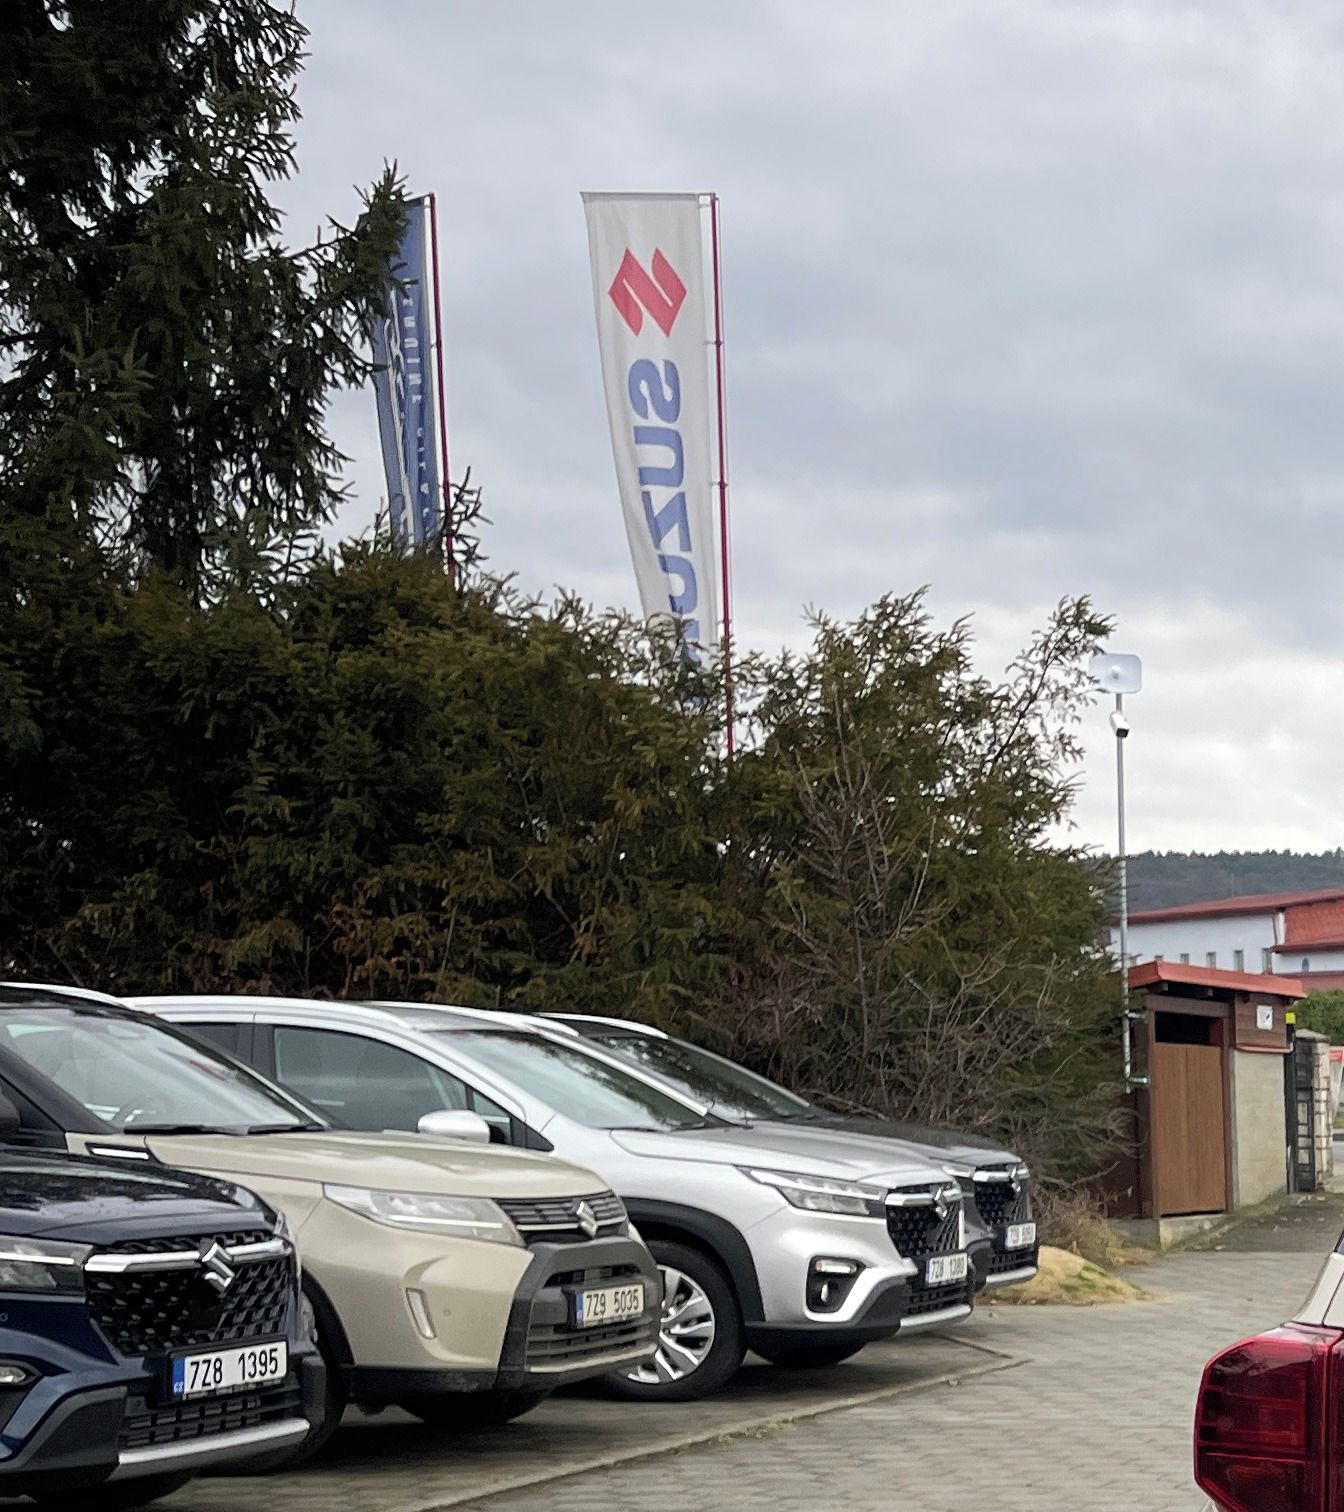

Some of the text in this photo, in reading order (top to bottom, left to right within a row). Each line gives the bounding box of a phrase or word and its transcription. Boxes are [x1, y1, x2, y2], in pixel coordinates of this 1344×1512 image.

[586, 1288, 639, 1318] 7Z9 5035
[190, 1347, 279, 1390] 7Z8 1395
